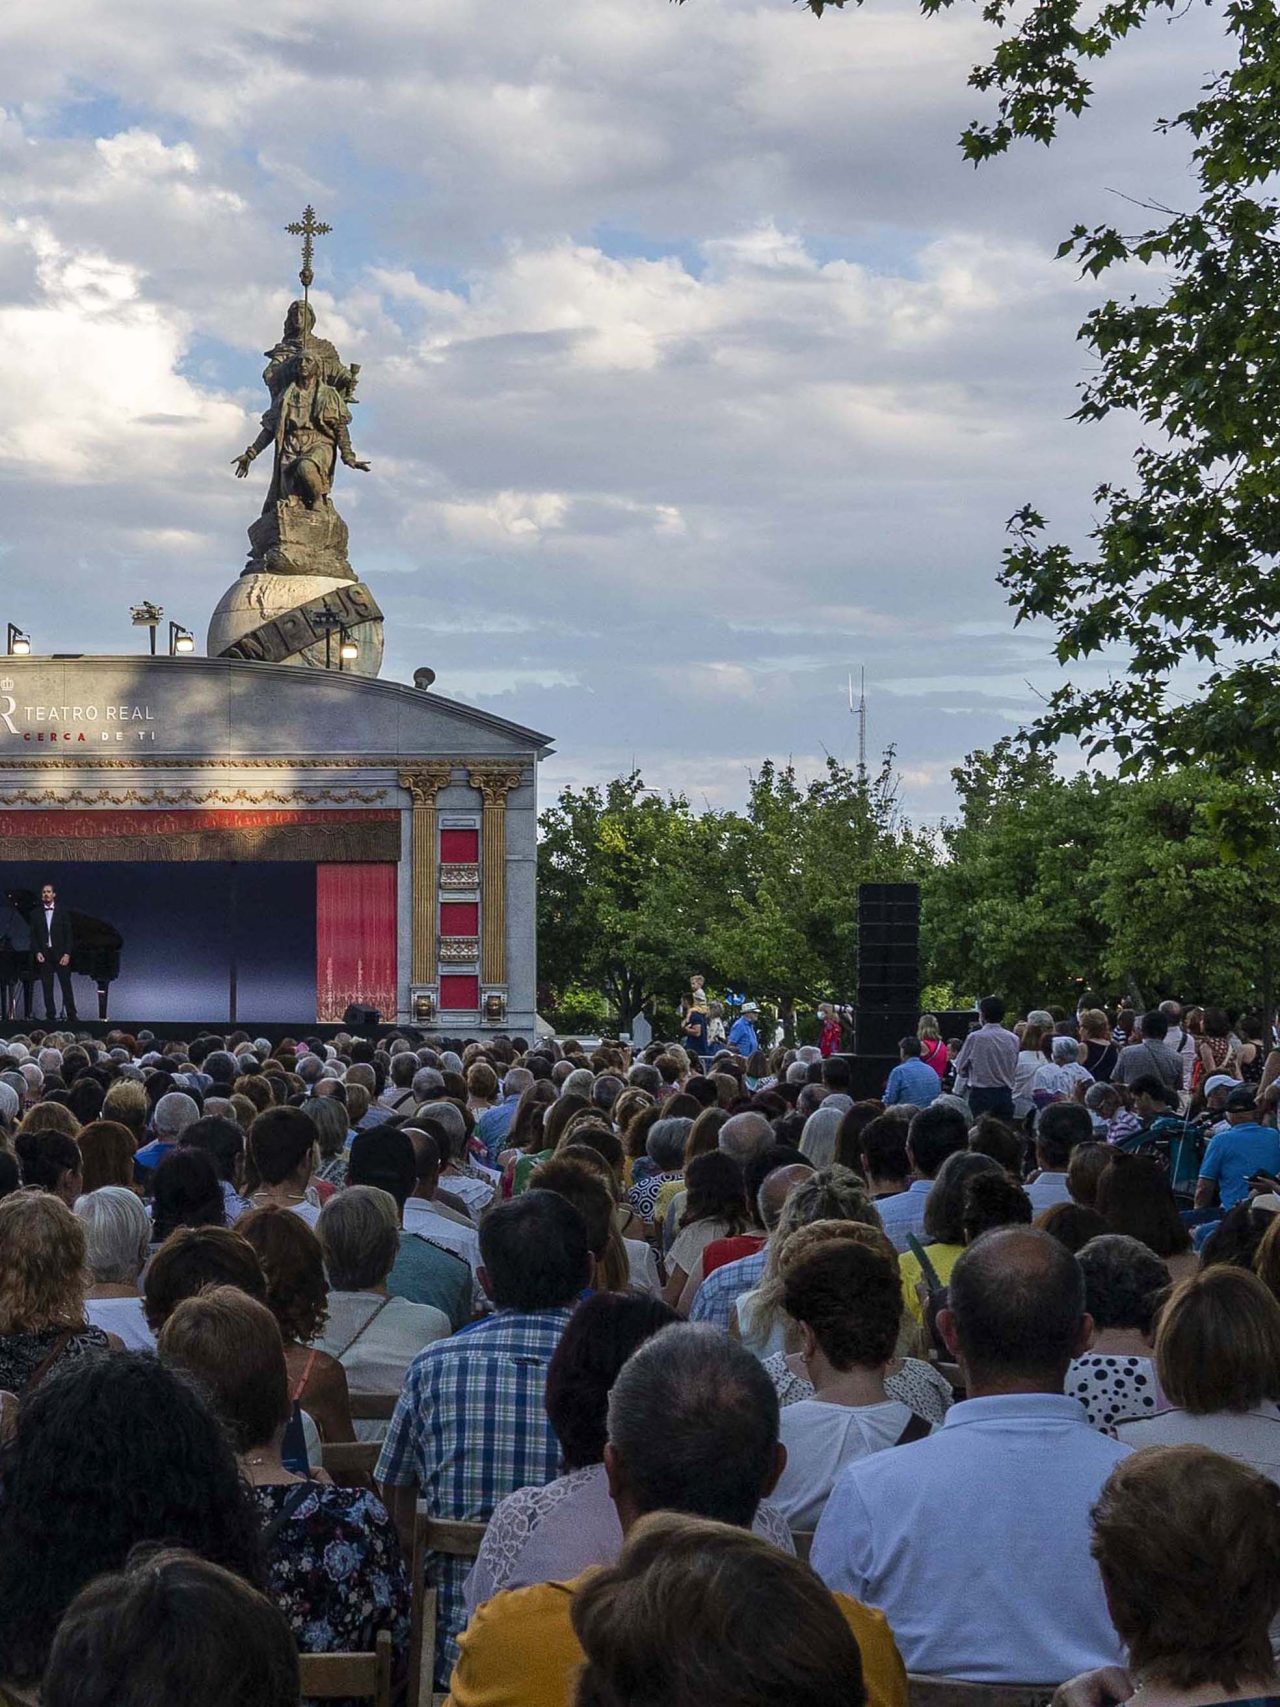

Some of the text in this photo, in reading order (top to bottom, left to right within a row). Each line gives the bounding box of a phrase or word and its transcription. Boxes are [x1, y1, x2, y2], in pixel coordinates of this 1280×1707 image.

[24, 705, 155, 721] TEATRO REAL
[23, 731, 156, 742] CERCA DE TI
